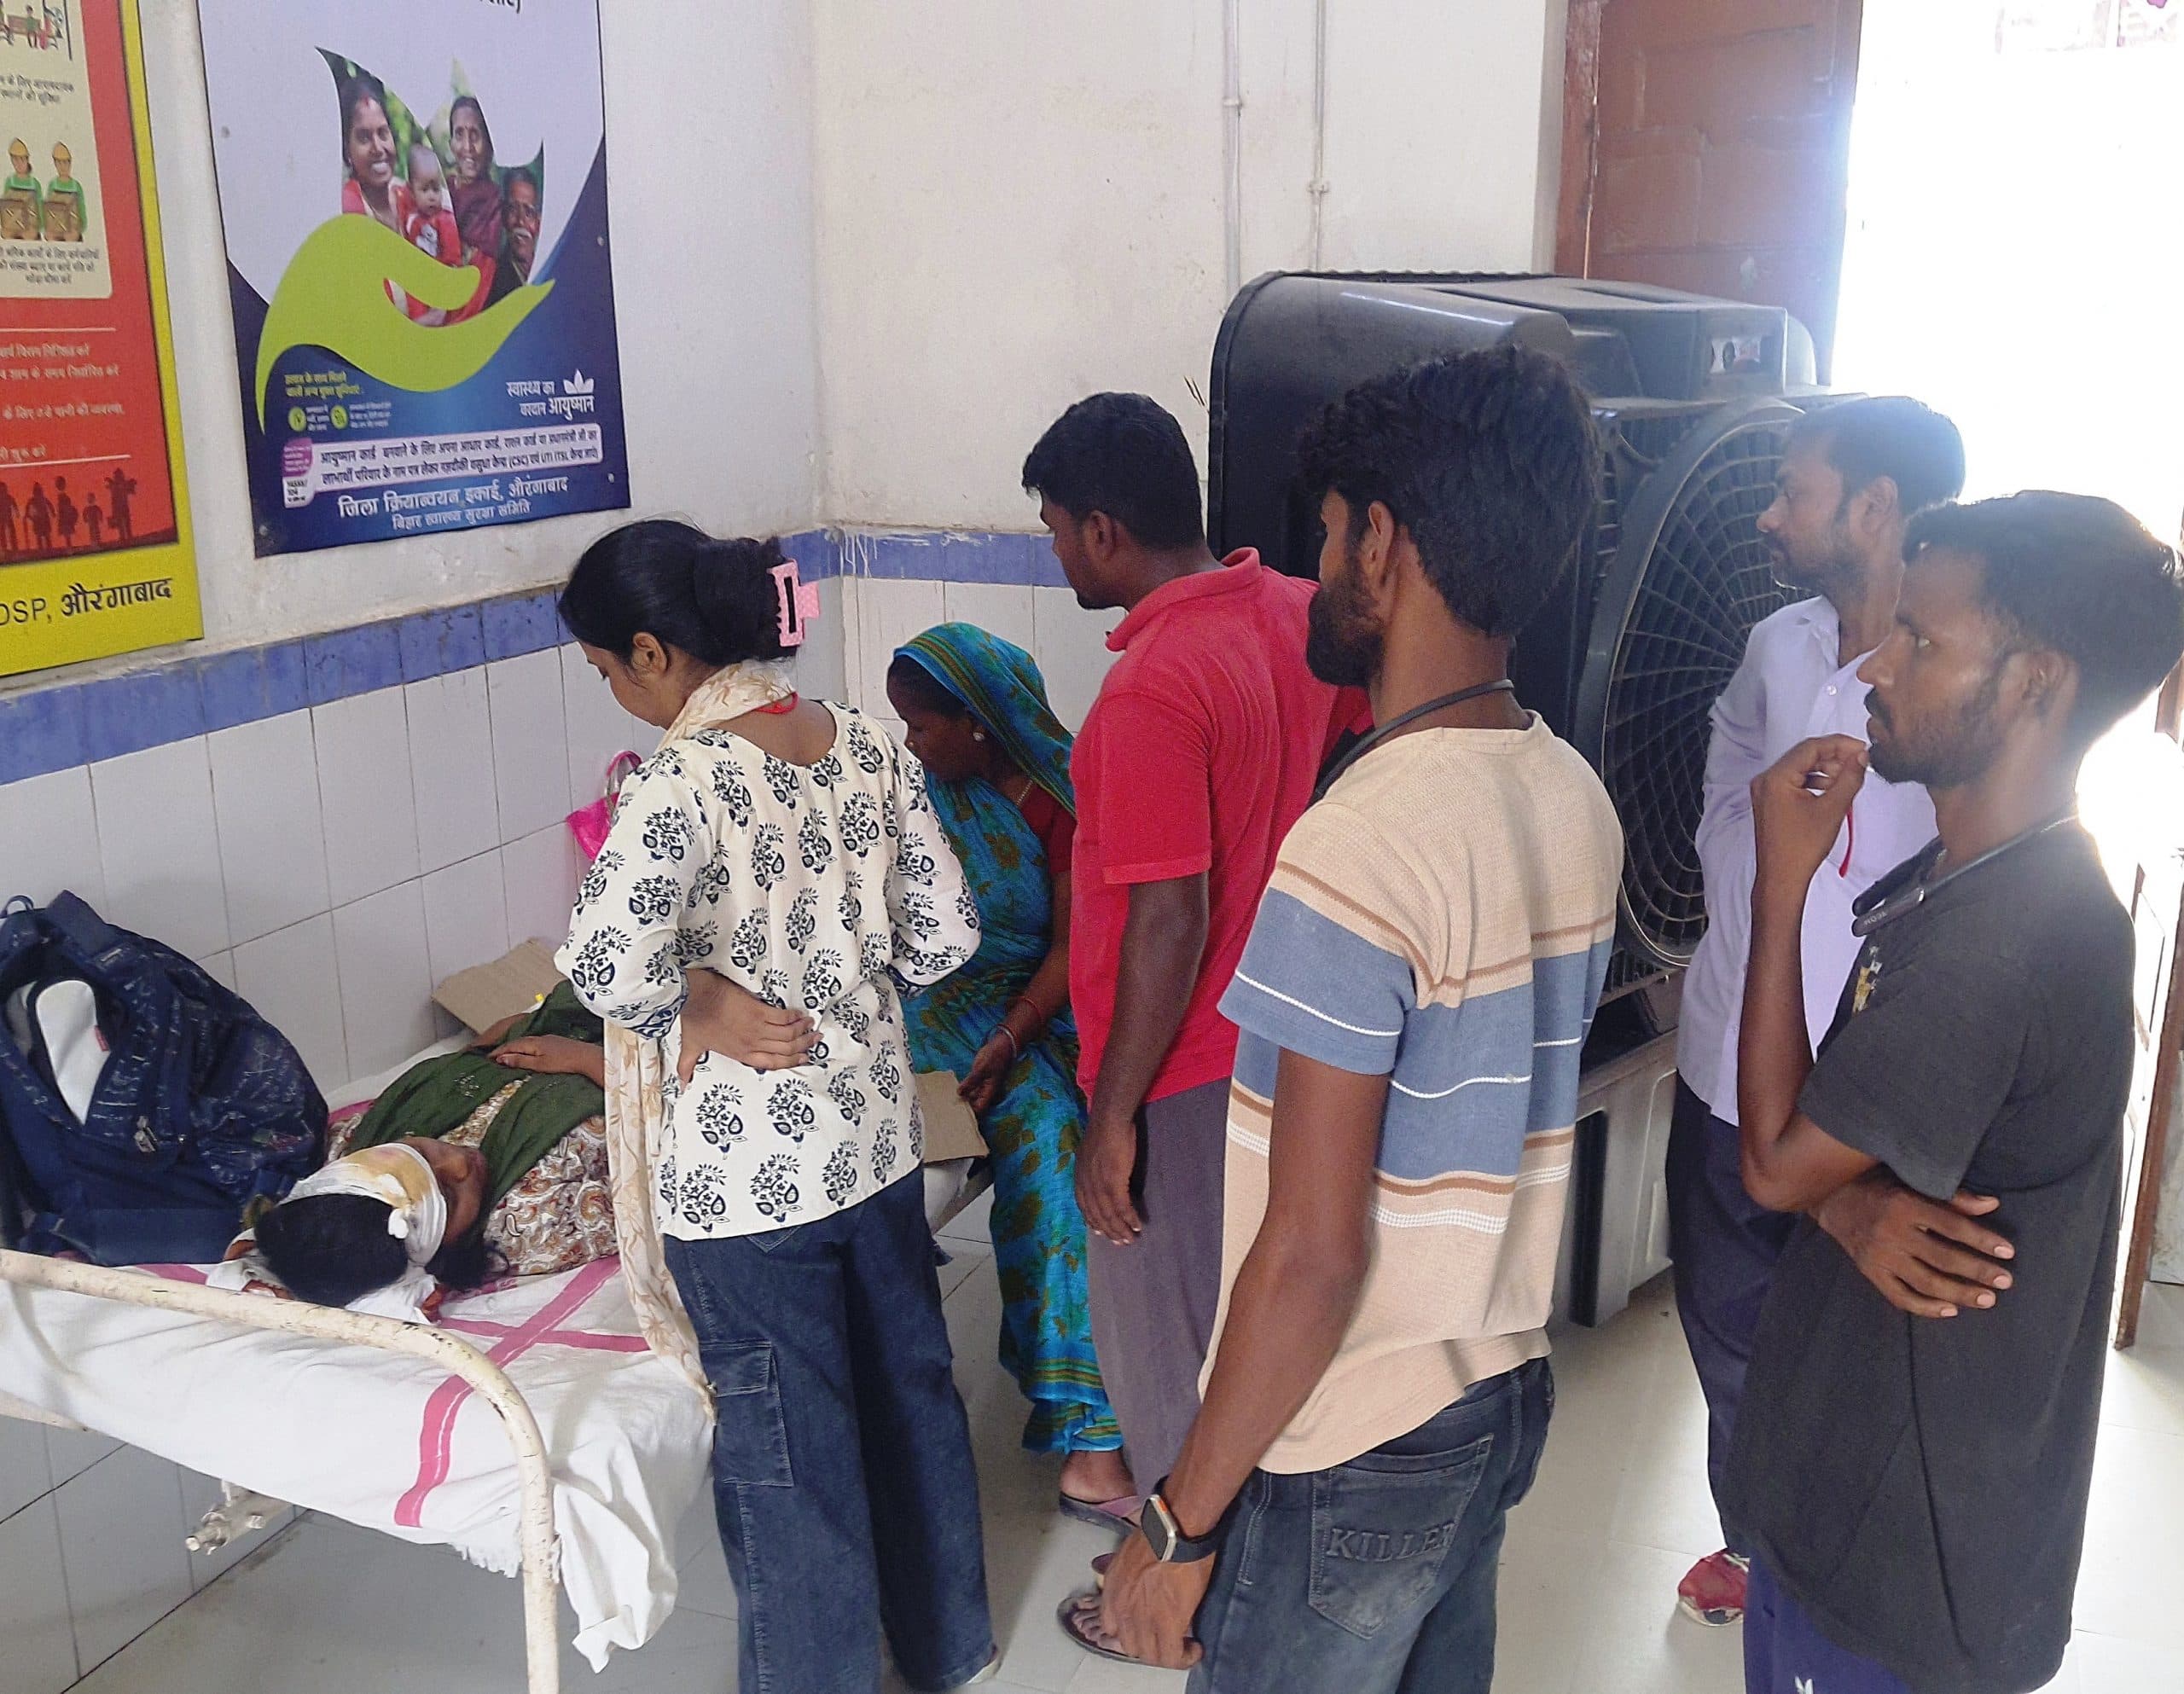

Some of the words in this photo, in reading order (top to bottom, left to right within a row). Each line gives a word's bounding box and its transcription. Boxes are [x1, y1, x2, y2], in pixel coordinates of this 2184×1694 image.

[543, 380, 555, 395] का
[549, 395, 595, 421] आयुष्मान
[338, 495, 380, 518] जिला
[508, 474, 570, 499] औरंगाबाद
[61, 577, 173, 617] औरंगाबाद
